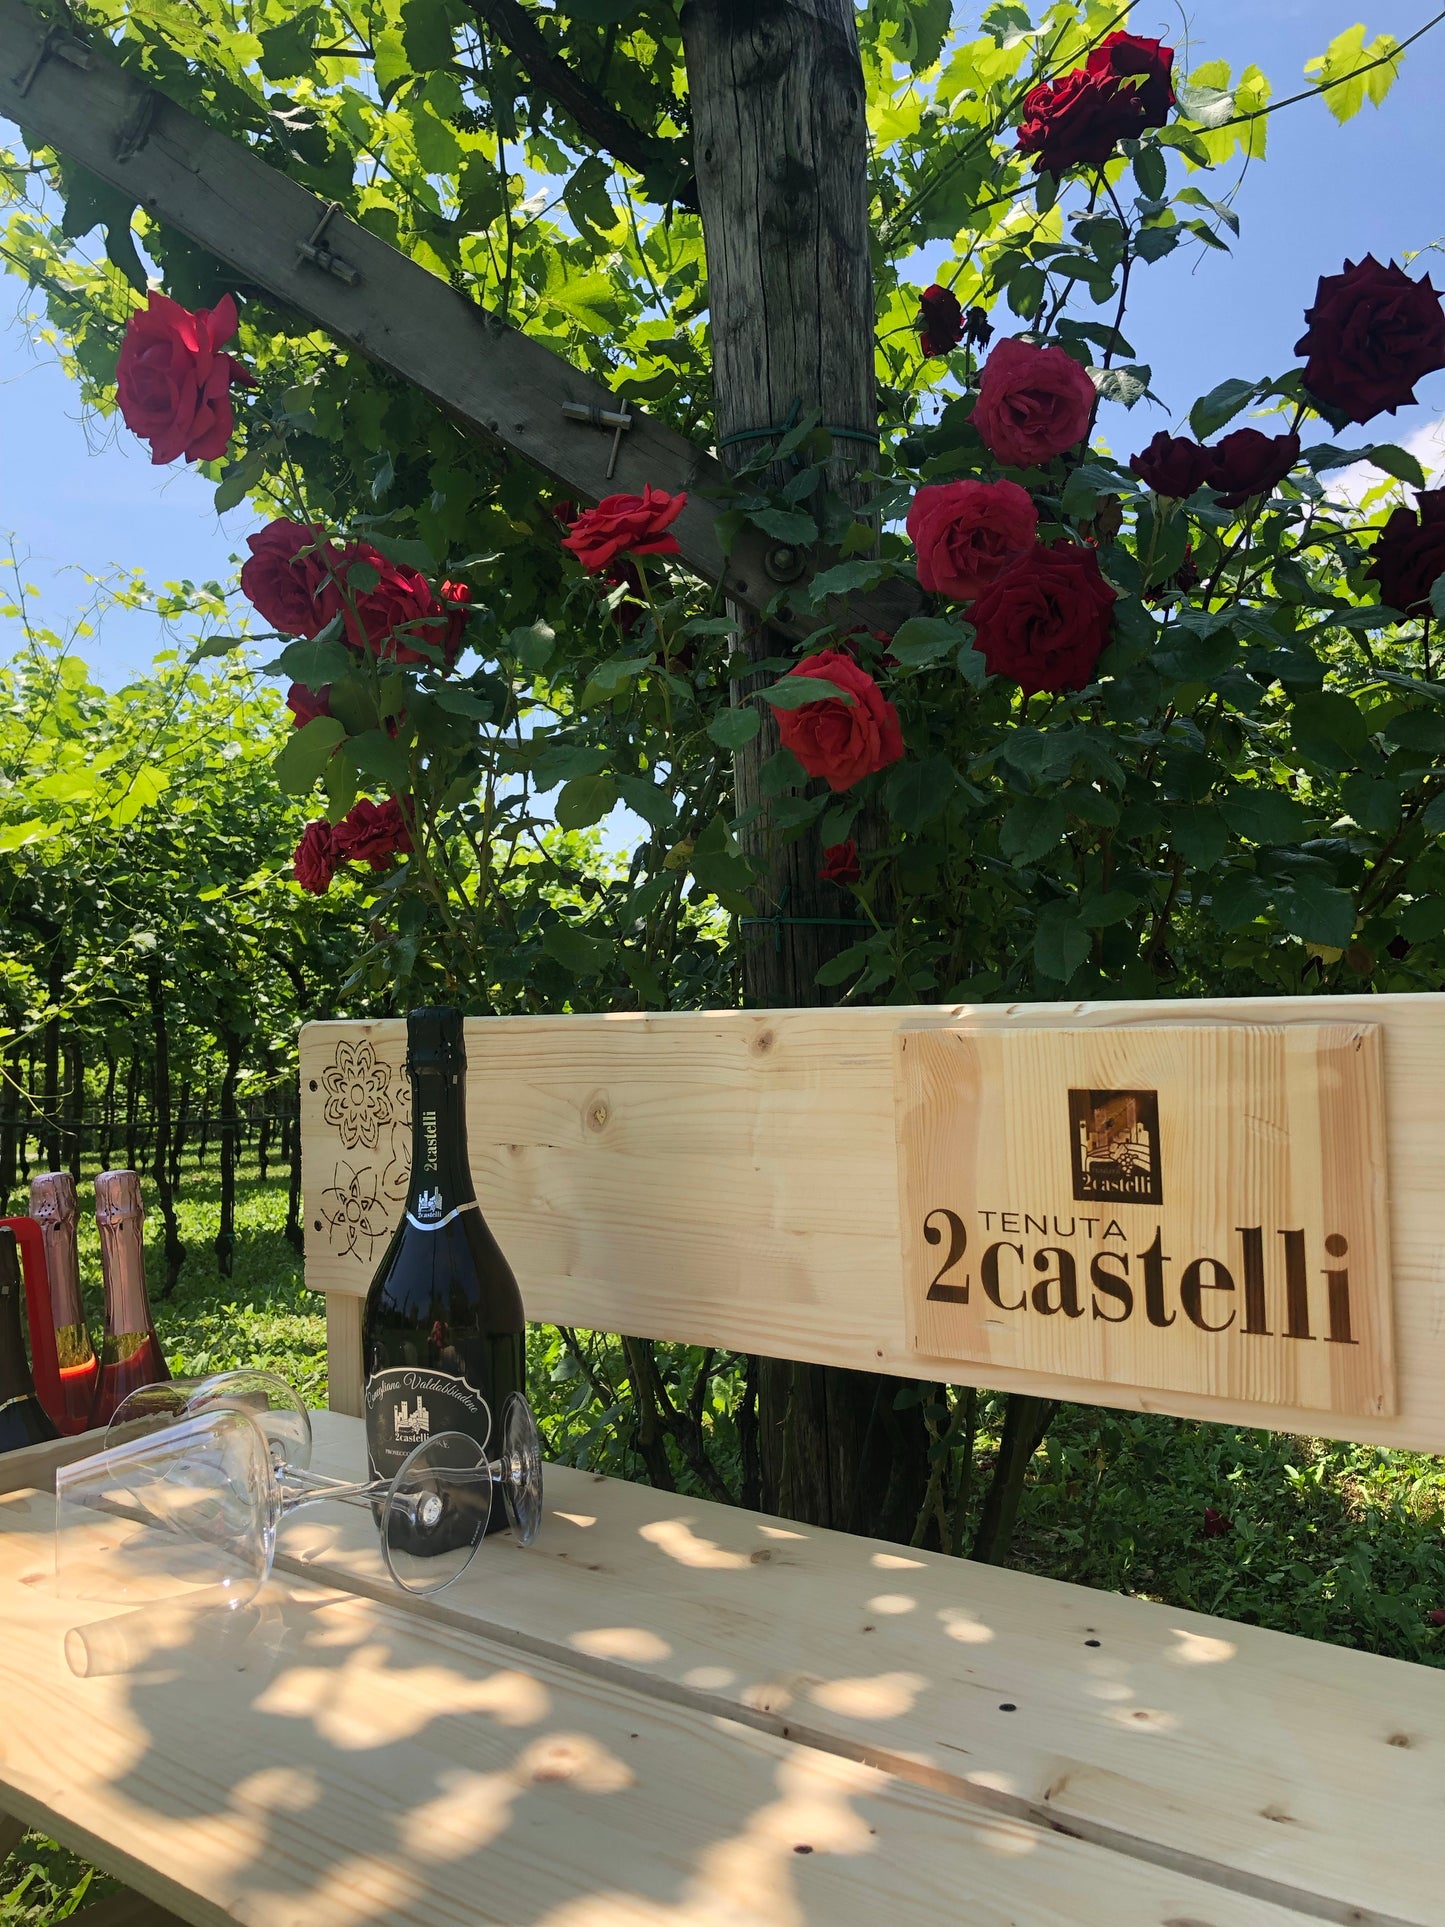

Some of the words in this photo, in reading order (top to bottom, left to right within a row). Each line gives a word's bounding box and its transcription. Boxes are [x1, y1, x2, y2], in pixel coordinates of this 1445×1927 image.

[423, 1110, 438, 1172] 2castelli
[1082, 1173, 1152, 1194] 2castelli
[978, 1210, 1127, 1241] TENUTA
[923, 1208, 1359, 1345] 2castelli
[394, 1433, 430, 1443] 2castelli
